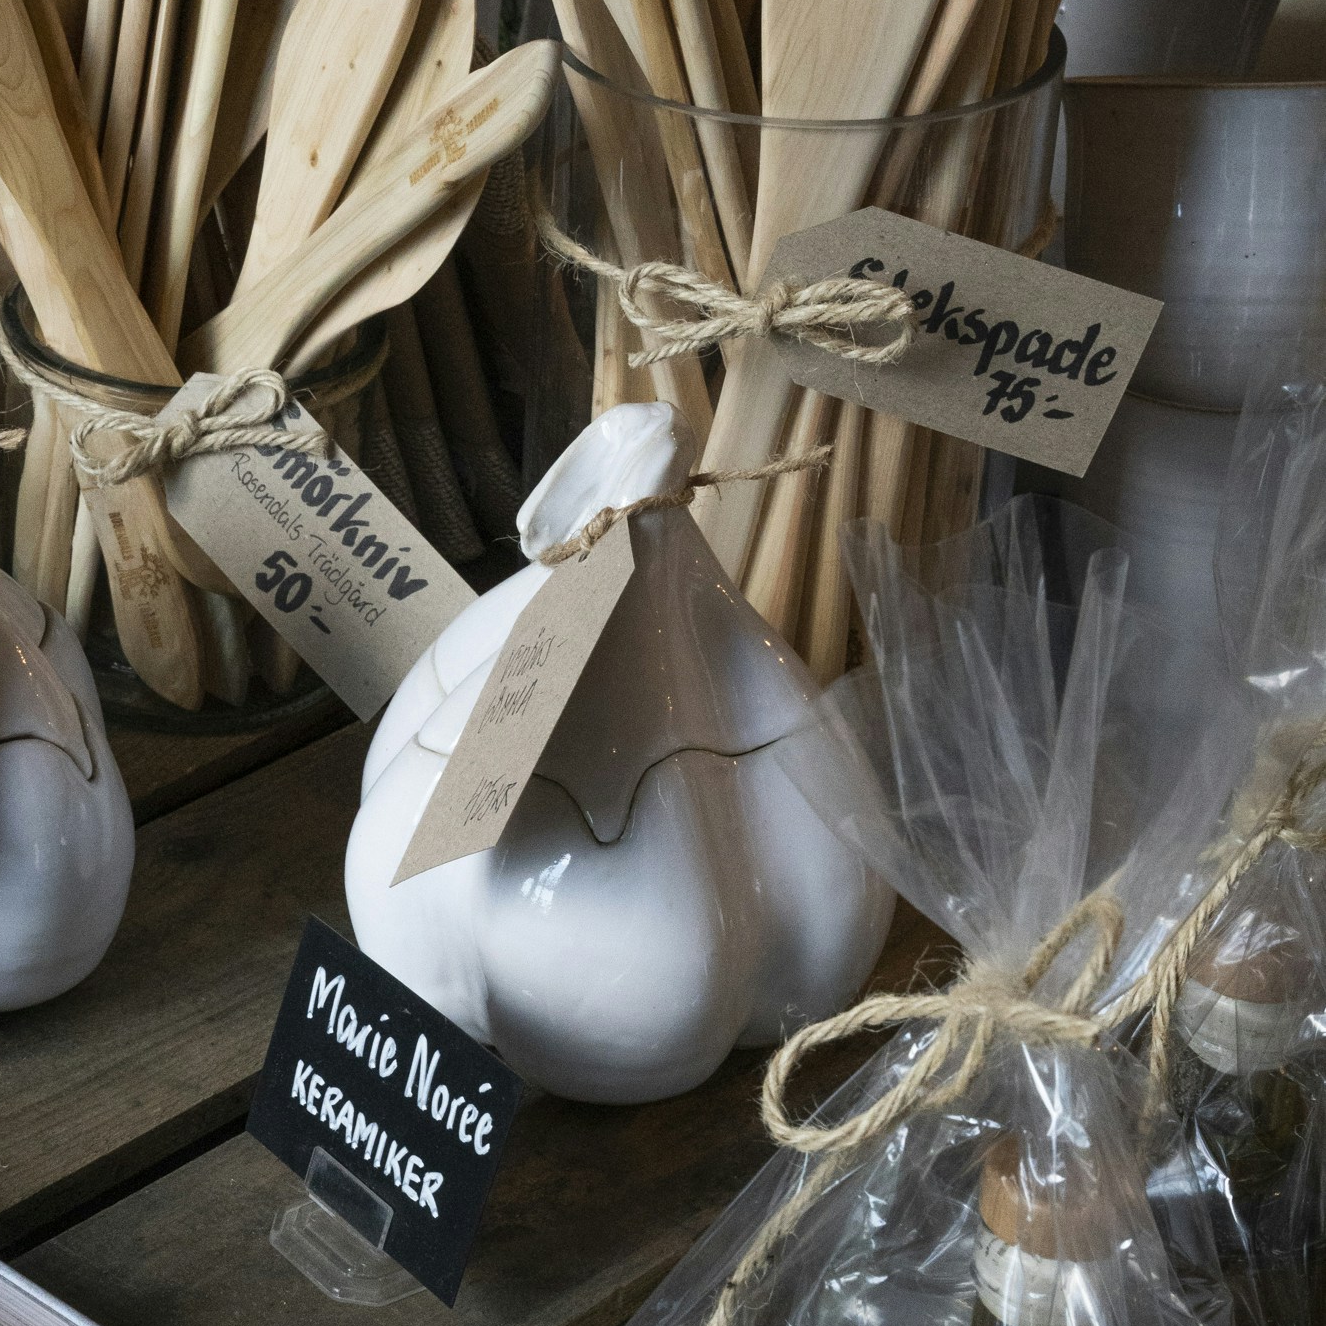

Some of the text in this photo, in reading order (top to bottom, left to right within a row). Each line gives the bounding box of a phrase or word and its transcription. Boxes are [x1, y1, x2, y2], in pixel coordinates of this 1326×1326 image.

[231, 452, 387, 628] Rosendals Trädgård
[291, 1059, 443, 1218] KERAMIKER
[306, 965, 493, 1155] Marie Norée
